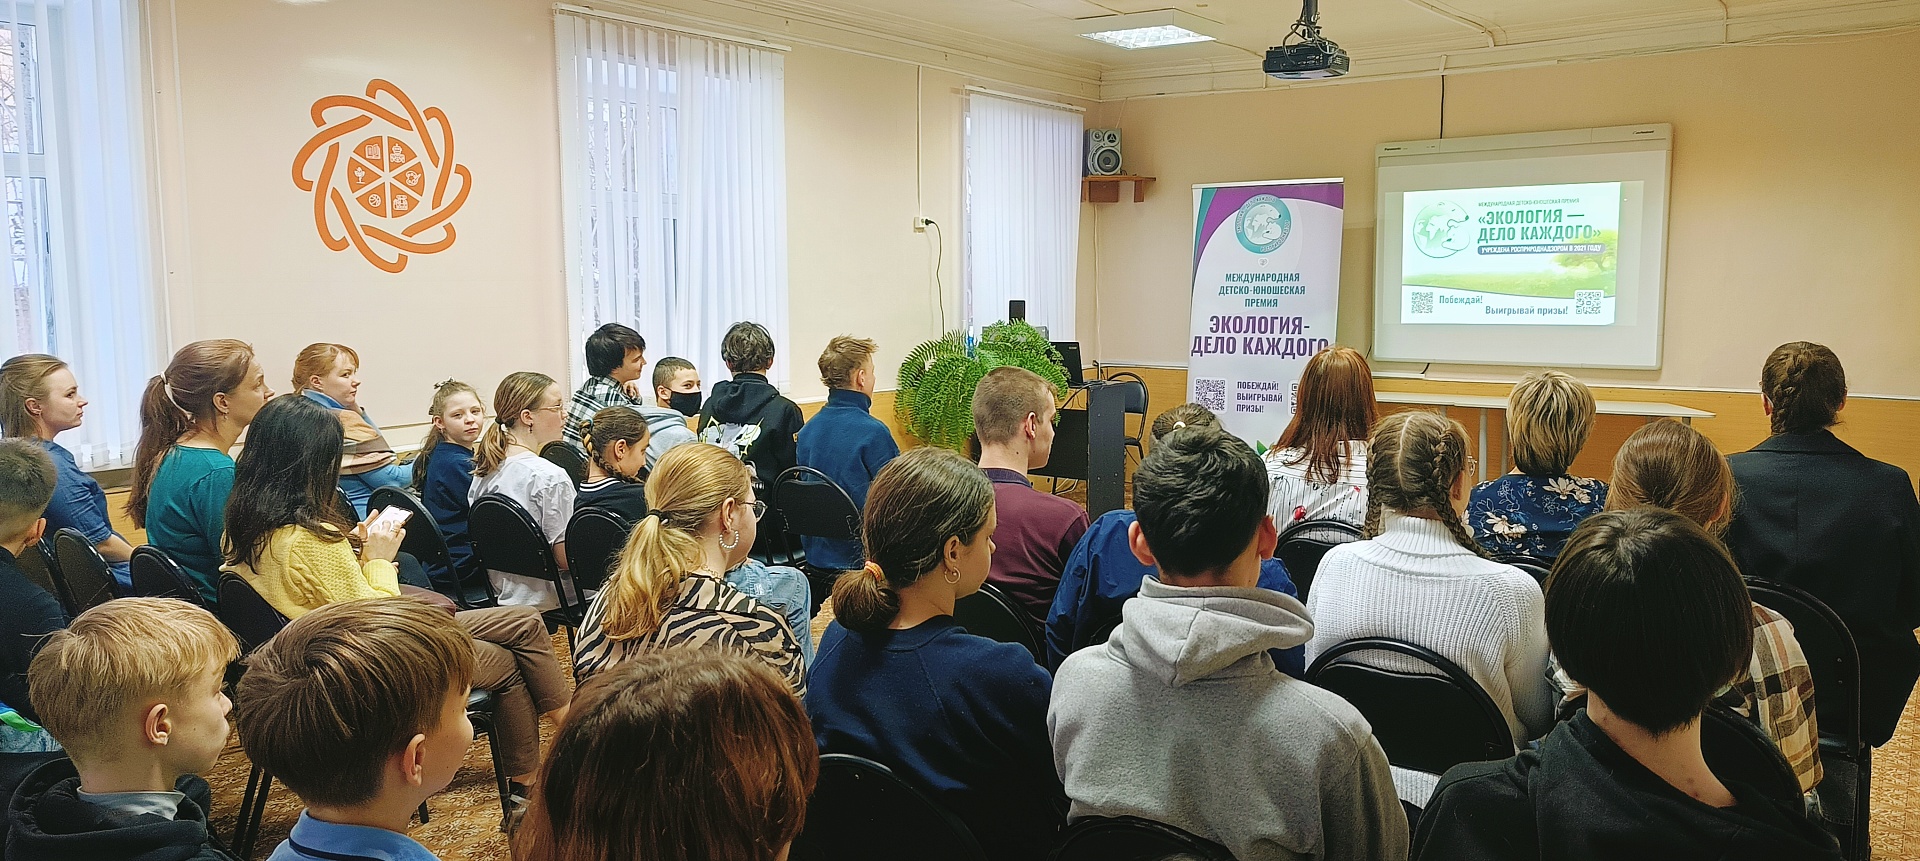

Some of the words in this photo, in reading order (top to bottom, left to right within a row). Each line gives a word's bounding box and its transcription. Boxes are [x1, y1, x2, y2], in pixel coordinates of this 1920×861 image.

[1478, 209, 1562, 225] «ЭКОЛОГИЯ
[1477, 227, 1516, 244] ДЕЛО
[1521, 225, 1601, 242] КАЖДОГО»
[1481, 246, 1510, 254] УЧРЕЖДЕНА
[1510, 245, 1568, 253] РОСПРИРОДНАДЗОРОМ
[1587, 244, 1601, 252] ГОДУ
[1225, 273, 1300, 284] МЕЖДУНАРОДНАЯ
[1218, 285, 1306, 296] ДЕТСКО-ЮНОШЕСКАЯ
[1244, 298, 1278, 308] ПРЕМИЯ
[1439, 295, 1483, 305] Побеждай!
[1485, 305, 1535, 316] Выигрывай
[1537, 306, 1569, 316] призы!
[1209, 315, 1310, 335] ЭКОЛОГИЯ-
[1191, 336, 1237, 357] ДЕЛО
[1237, 381, 1279, 391] ПОБЕЖДАЙ!
[1236, 392, 1283, 402] ВЫИГРЫВАЙ
[1236, 404, 1264, 413] ПРИЗЫ!
